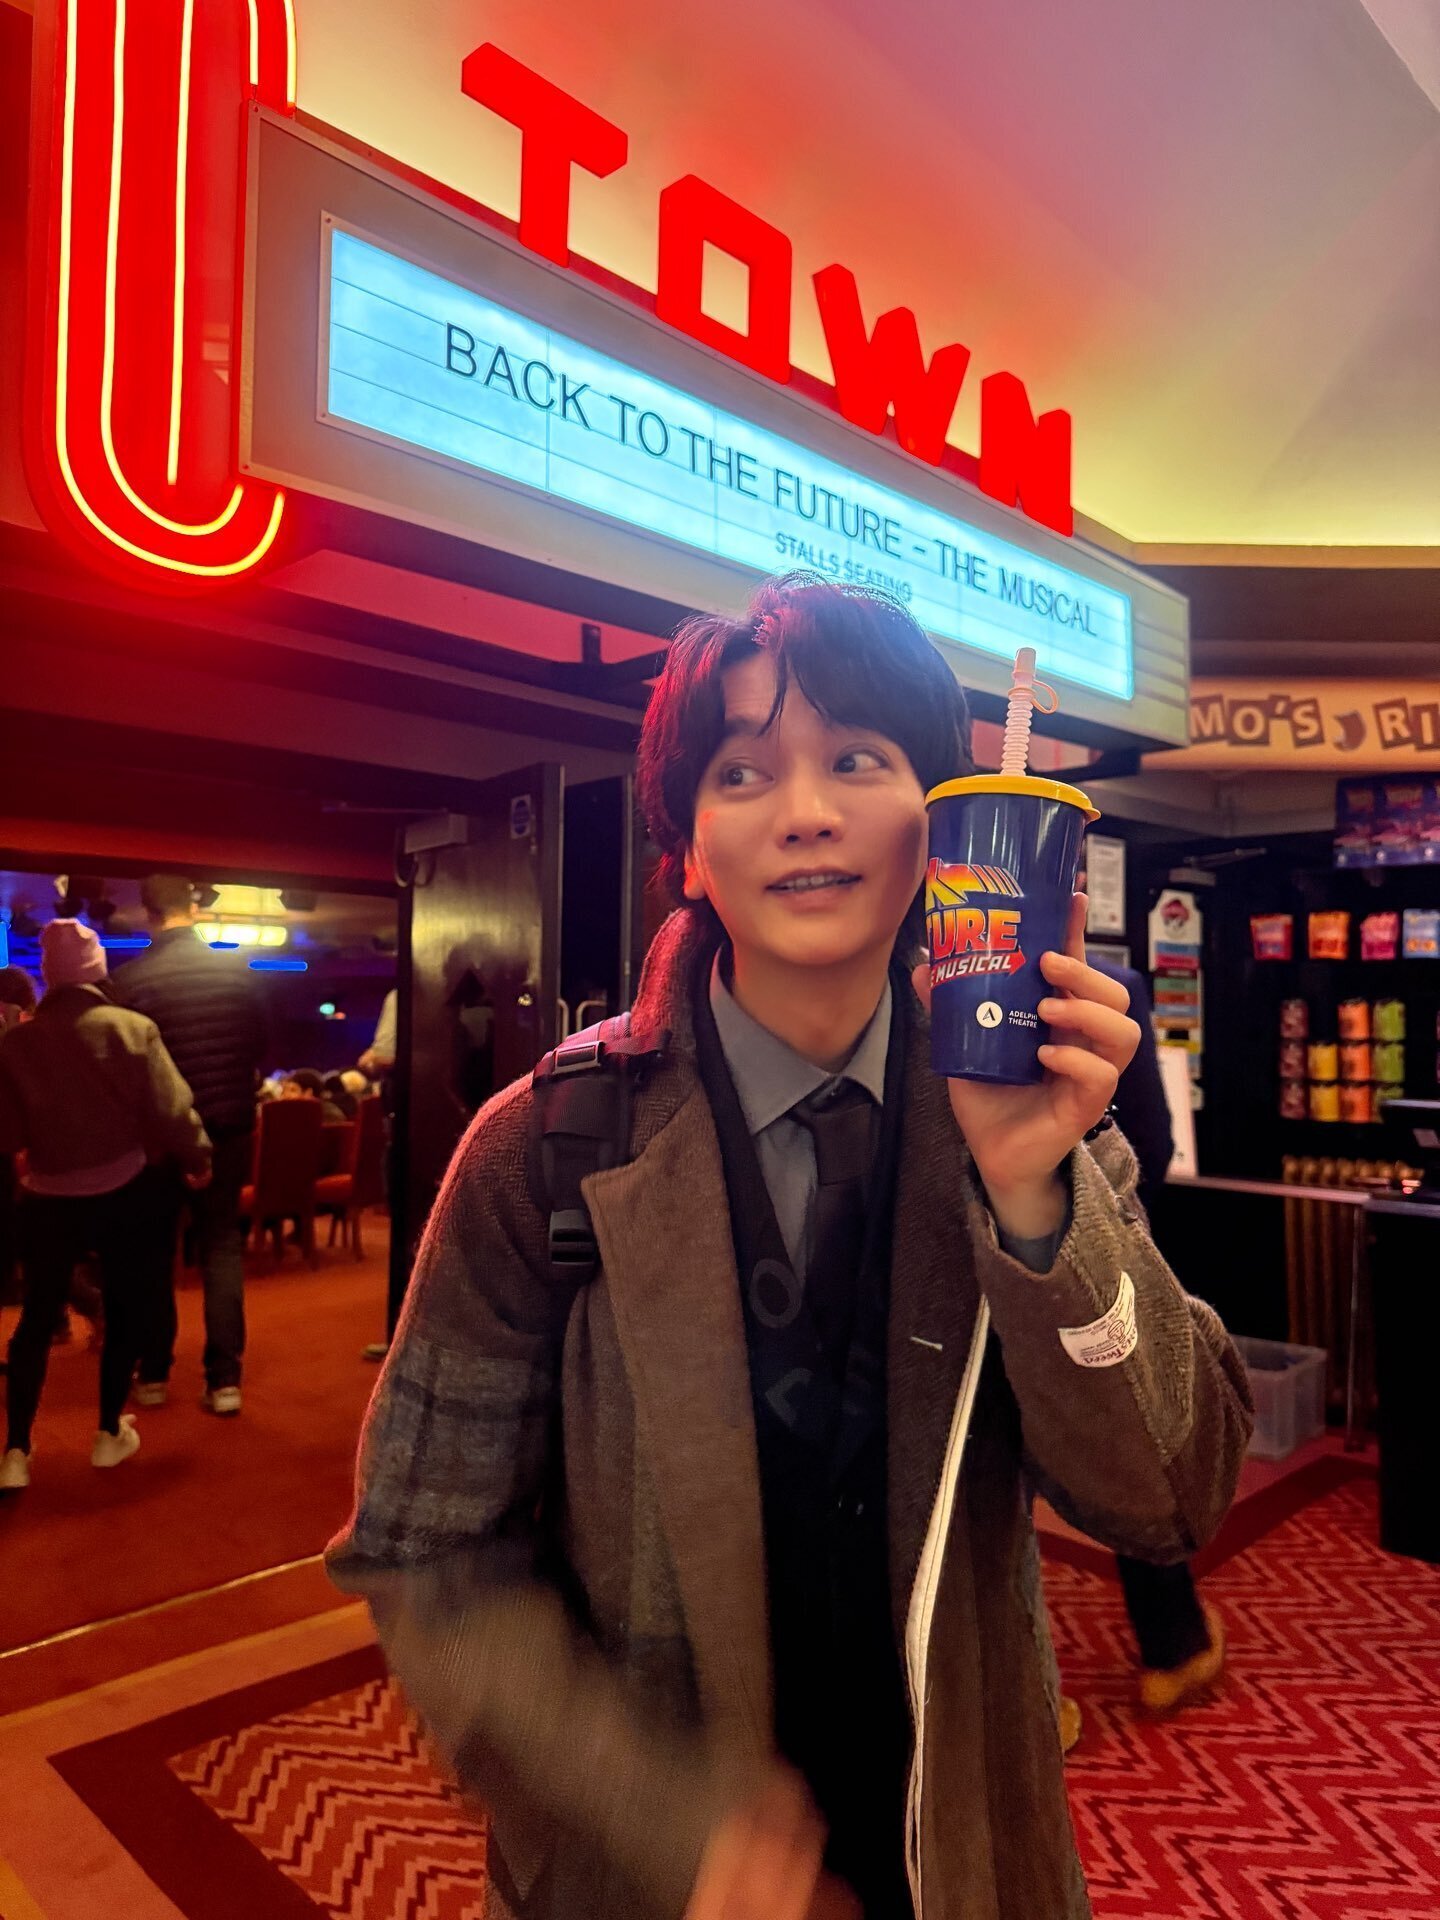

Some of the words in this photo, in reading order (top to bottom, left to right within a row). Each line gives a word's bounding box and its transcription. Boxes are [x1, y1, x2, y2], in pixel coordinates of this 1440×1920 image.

[461, 42, 1073, 537] TOWN
[445, 322, 591, 429] BACK
[609, 394, 669, 457] TO
[680, 427, 758, 498] THE
[775, 469, 901, 558] FUTURE
[933, 539, 987, 593] THE
[1000, 567, 1097, 637] MUSICAL
[776, 532, 840, 575] STALLS
[843, 558, 913, 602] SEATING
[926, 908, 1021, 960] URE
[935, 955, 1011, 982] MUSICAL
[1008, 1017, 1038, 1029] THEATRE
